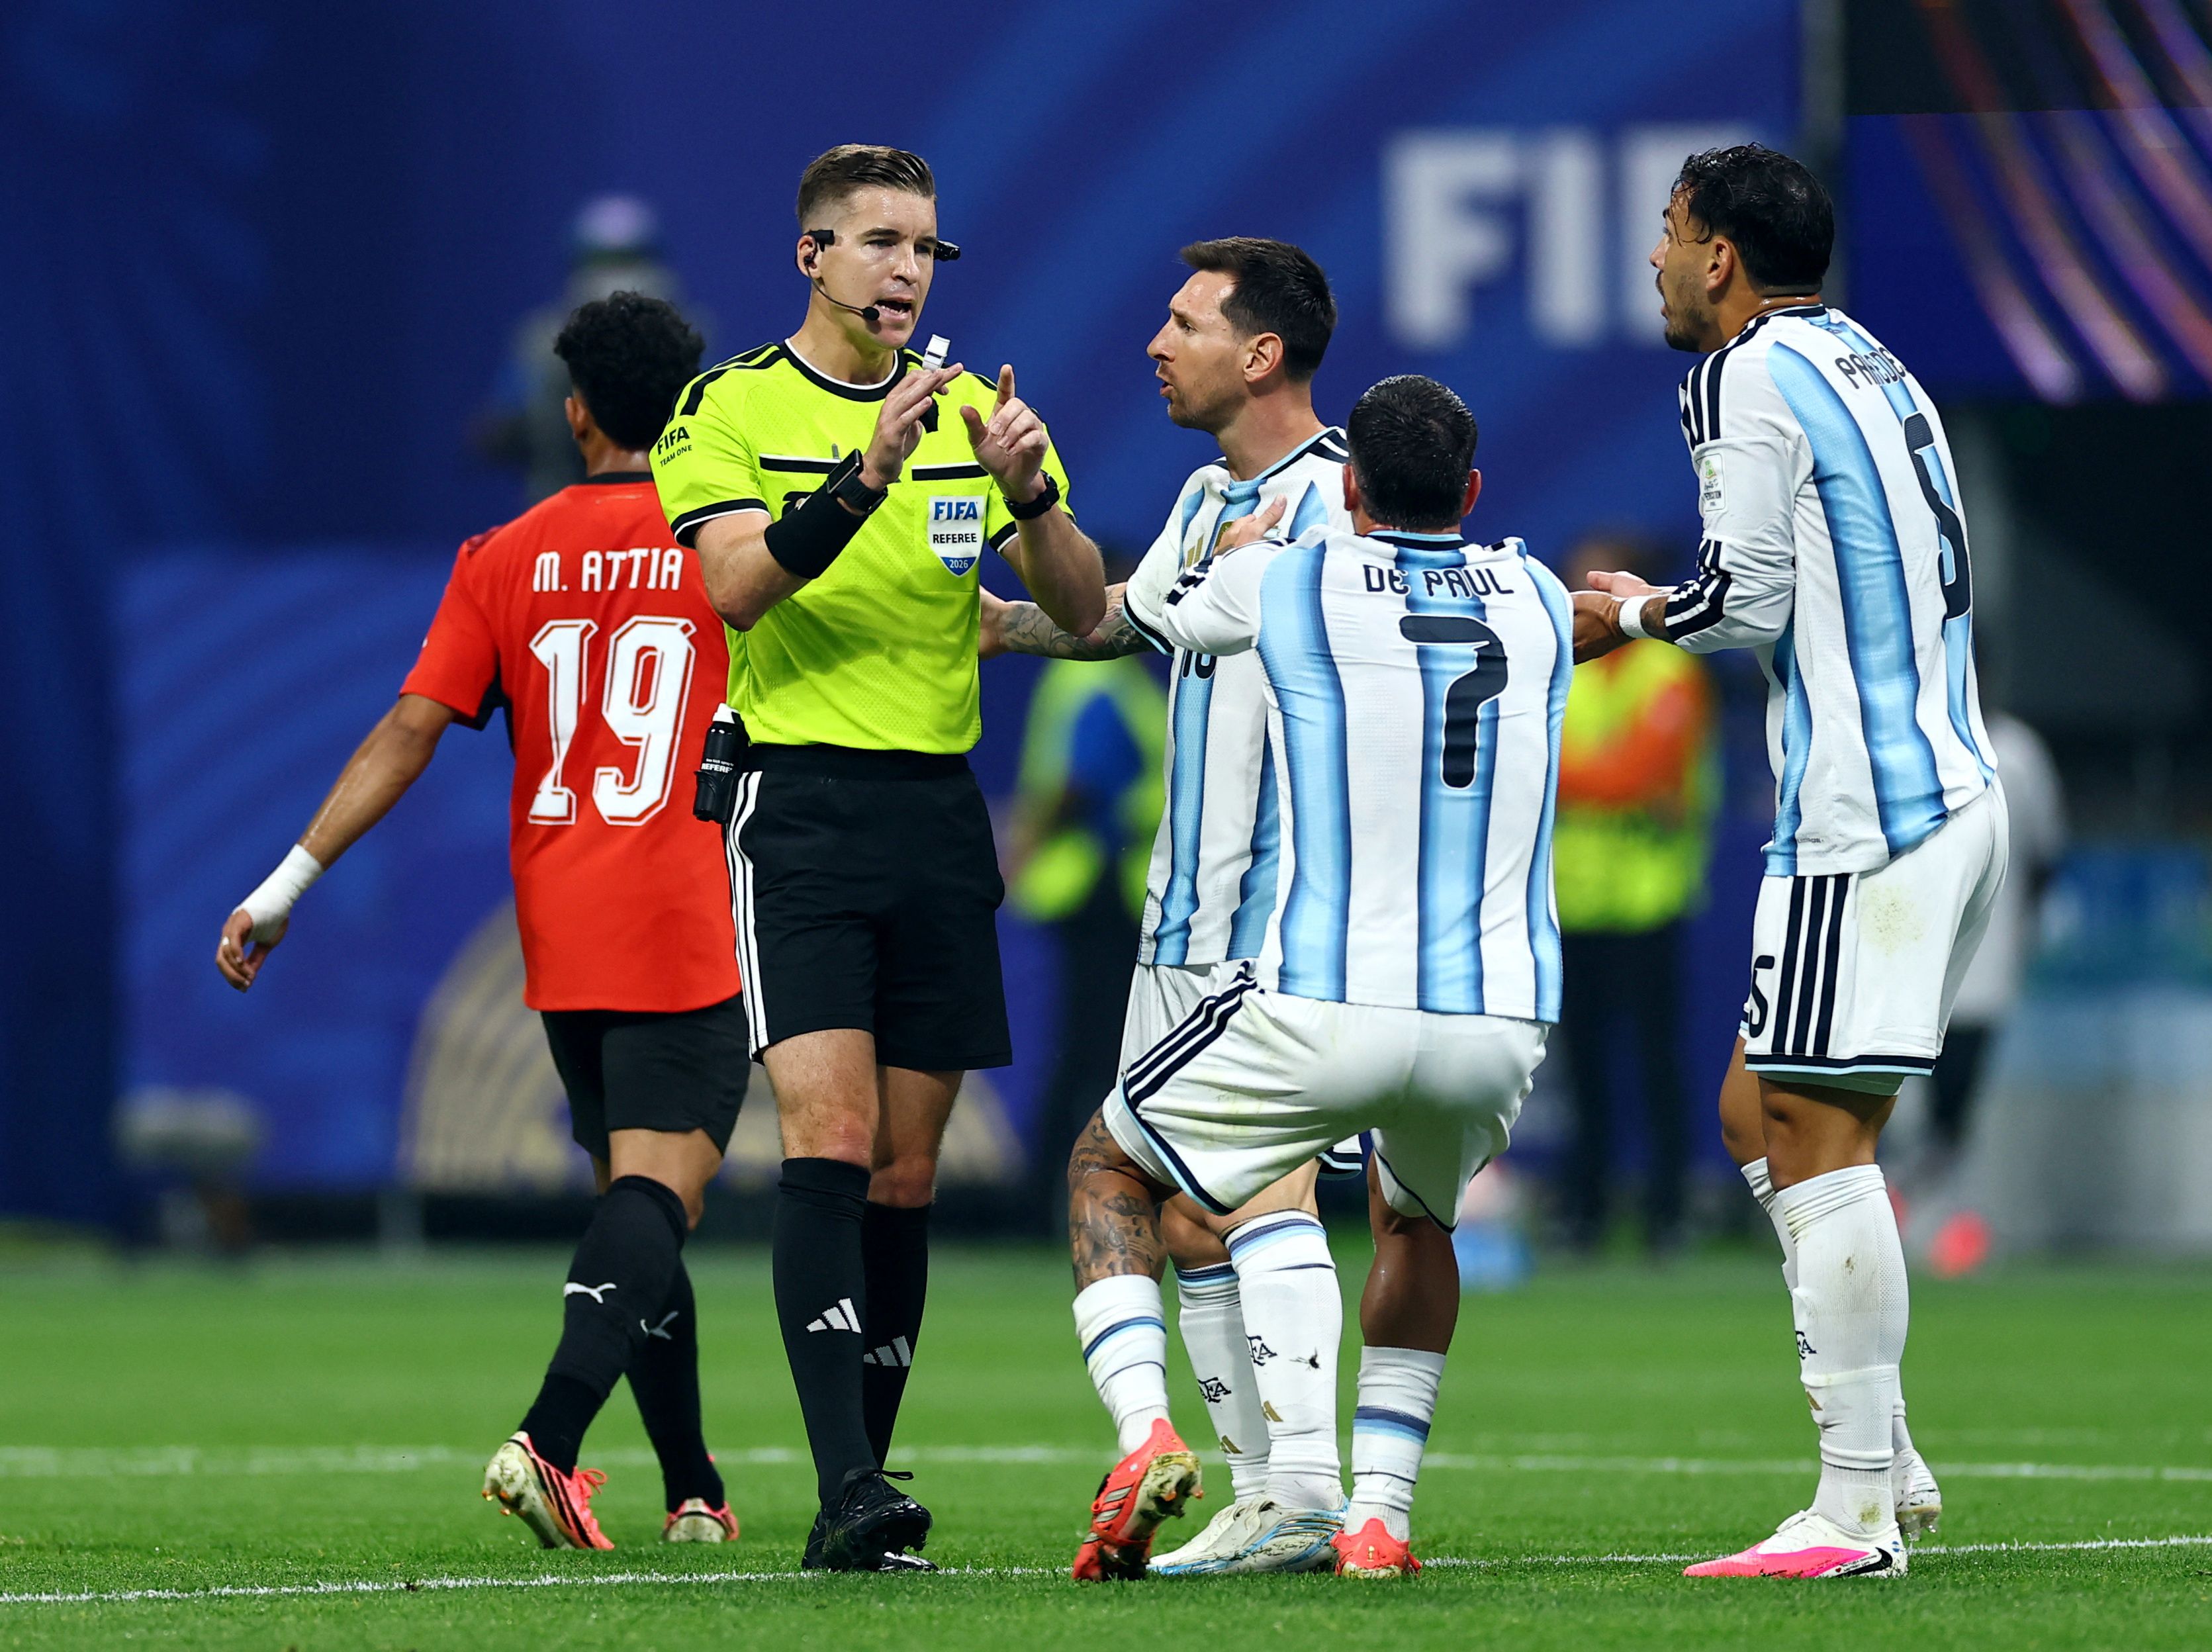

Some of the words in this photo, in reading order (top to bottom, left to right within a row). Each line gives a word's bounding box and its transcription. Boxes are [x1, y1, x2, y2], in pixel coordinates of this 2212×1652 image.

[1835, 347, 1907, 389] PAREDE
[657, 426, 690, 455] FIFA
[660, 452, 675, 467] TEAM
[676, 445, 692, 456] ONE
[934, 502, 978, 520] FIFA
[1903, 411, 1970, 620] 5
[933, 533, 978, 543] REFEREE
[533, 551, 568, 592] M.
[581, 548, 683, 592] ATTIA
[949, 559, 968, 569] 2026
[1363, 565, 1409, 594] DE
[1423, 569, 1514, 597] PAUL
[529, 615, 698, 826] 19
[1399, 615, 1509, 789] 7
[1749, 954, 1774, 1038] 5
